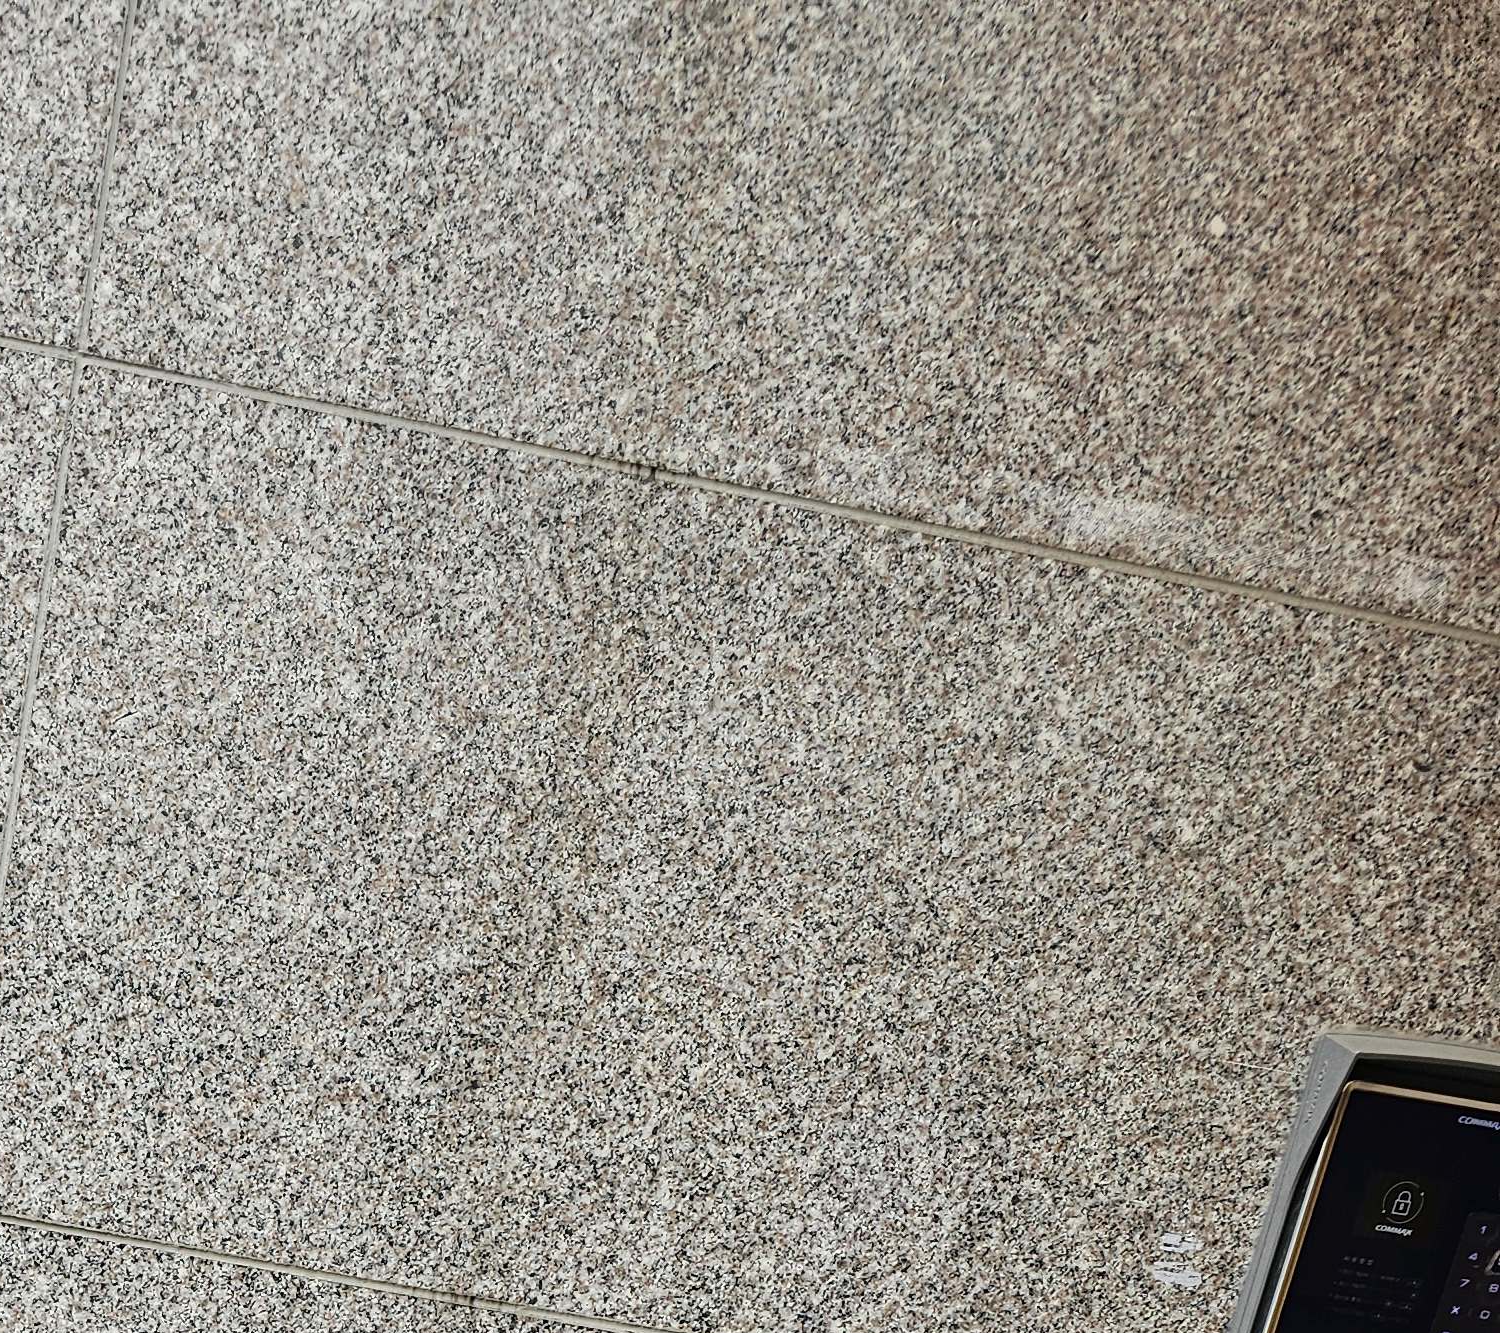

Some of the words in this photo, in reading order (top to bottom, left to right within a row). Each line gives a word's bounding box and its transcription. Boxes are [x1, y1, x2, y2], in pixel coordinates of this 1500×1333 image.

[1479, 1225, 1488, 1235] 1
[1468, 1252, 1479, 1261] 4
[1459, 1278, 1471, 1288] 7
